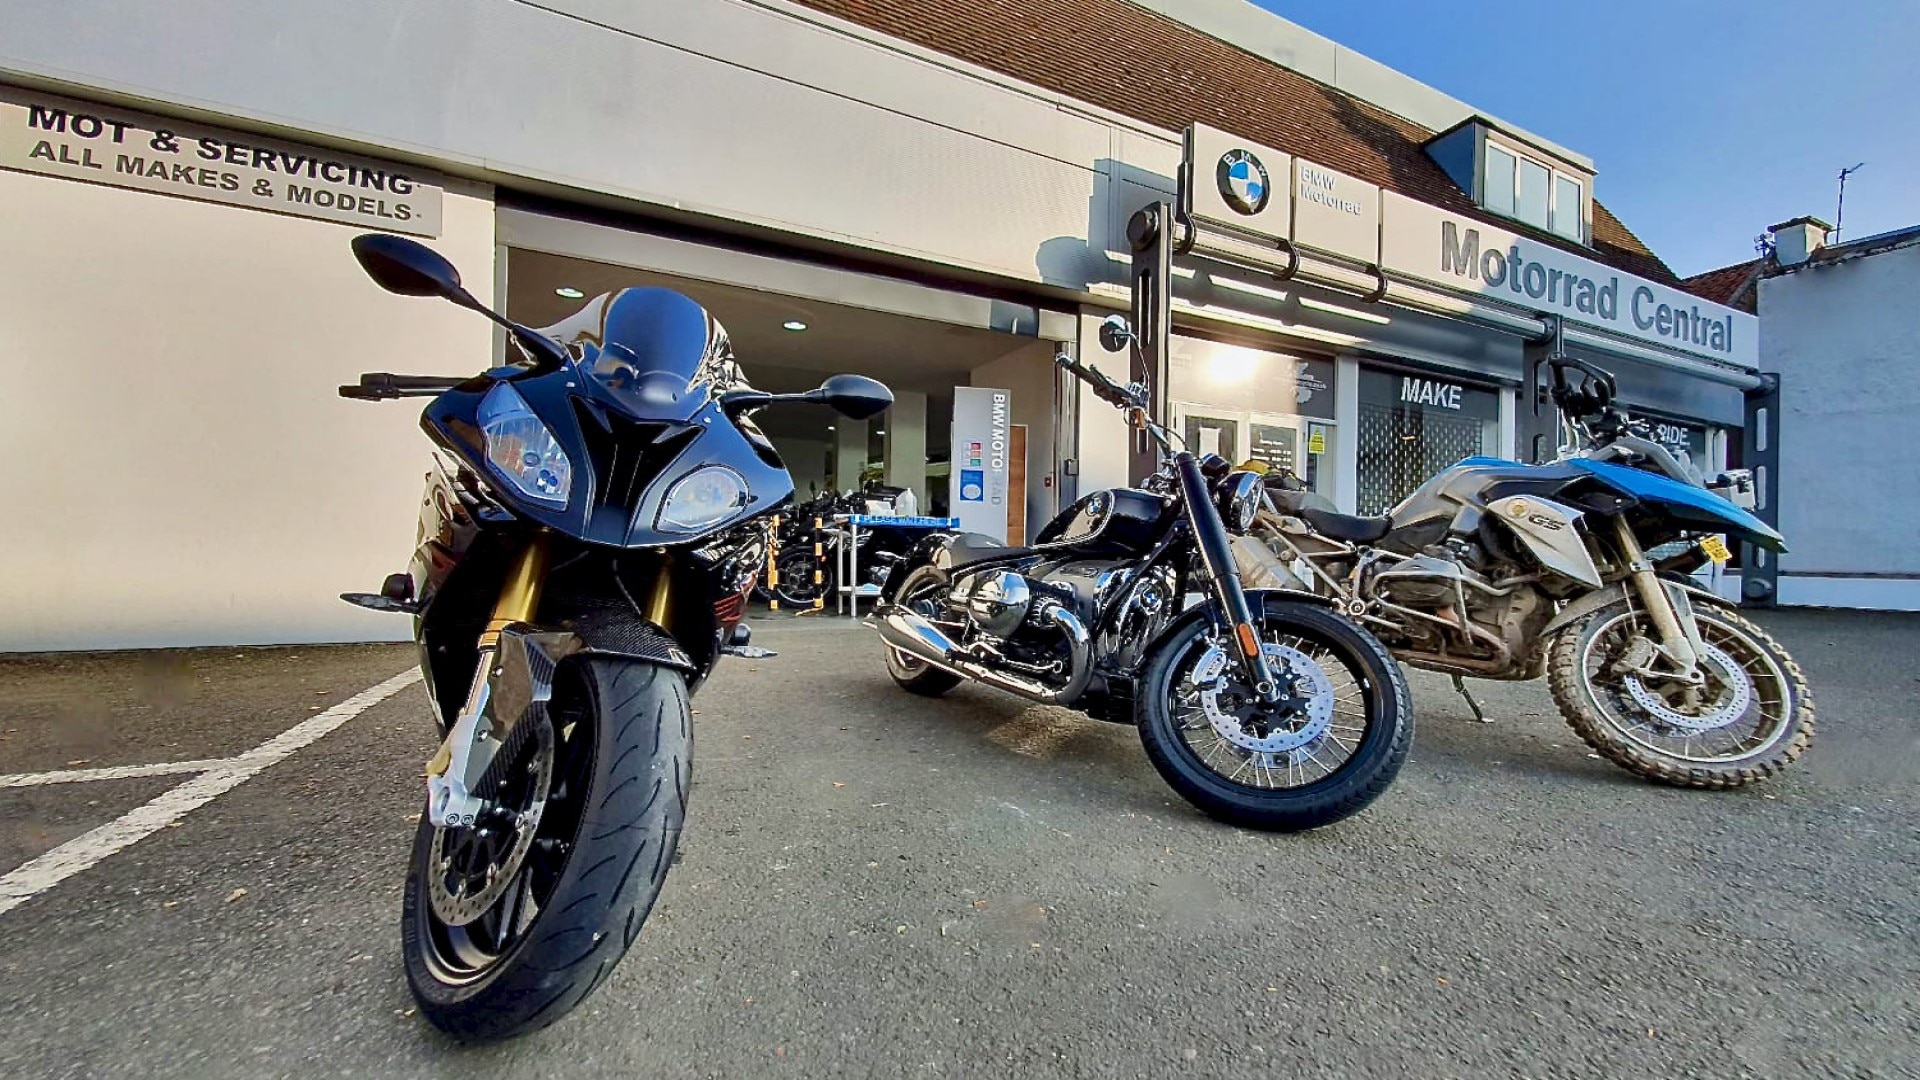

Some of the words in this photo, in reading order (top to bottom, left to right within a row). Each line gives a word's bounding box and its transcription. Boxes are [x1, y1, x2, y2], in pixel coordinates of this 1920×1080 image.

[28, 104, 134, 143] MOT
[150, 129, 180, 154] &
[197, 137, 413, 195] SERVICING
[1223, 150, 1267, 176] BMW
[29, 140, 102, 169] ALL
[116, 155, 239, 192] MAKES
[251, 179, 274, 198] &
[286, 184, 412, 221] MODELS
[1301, 167, 1335, 190] BMW
[1301, 183, 1361, 216] Motorrad
[1442, 221, 1618, 320] Motorrad
[1631, 286, 1732, 353] Central
[1401, 377, 1462, 410] MAKE
[992, 394, 1006, 427] BMW
